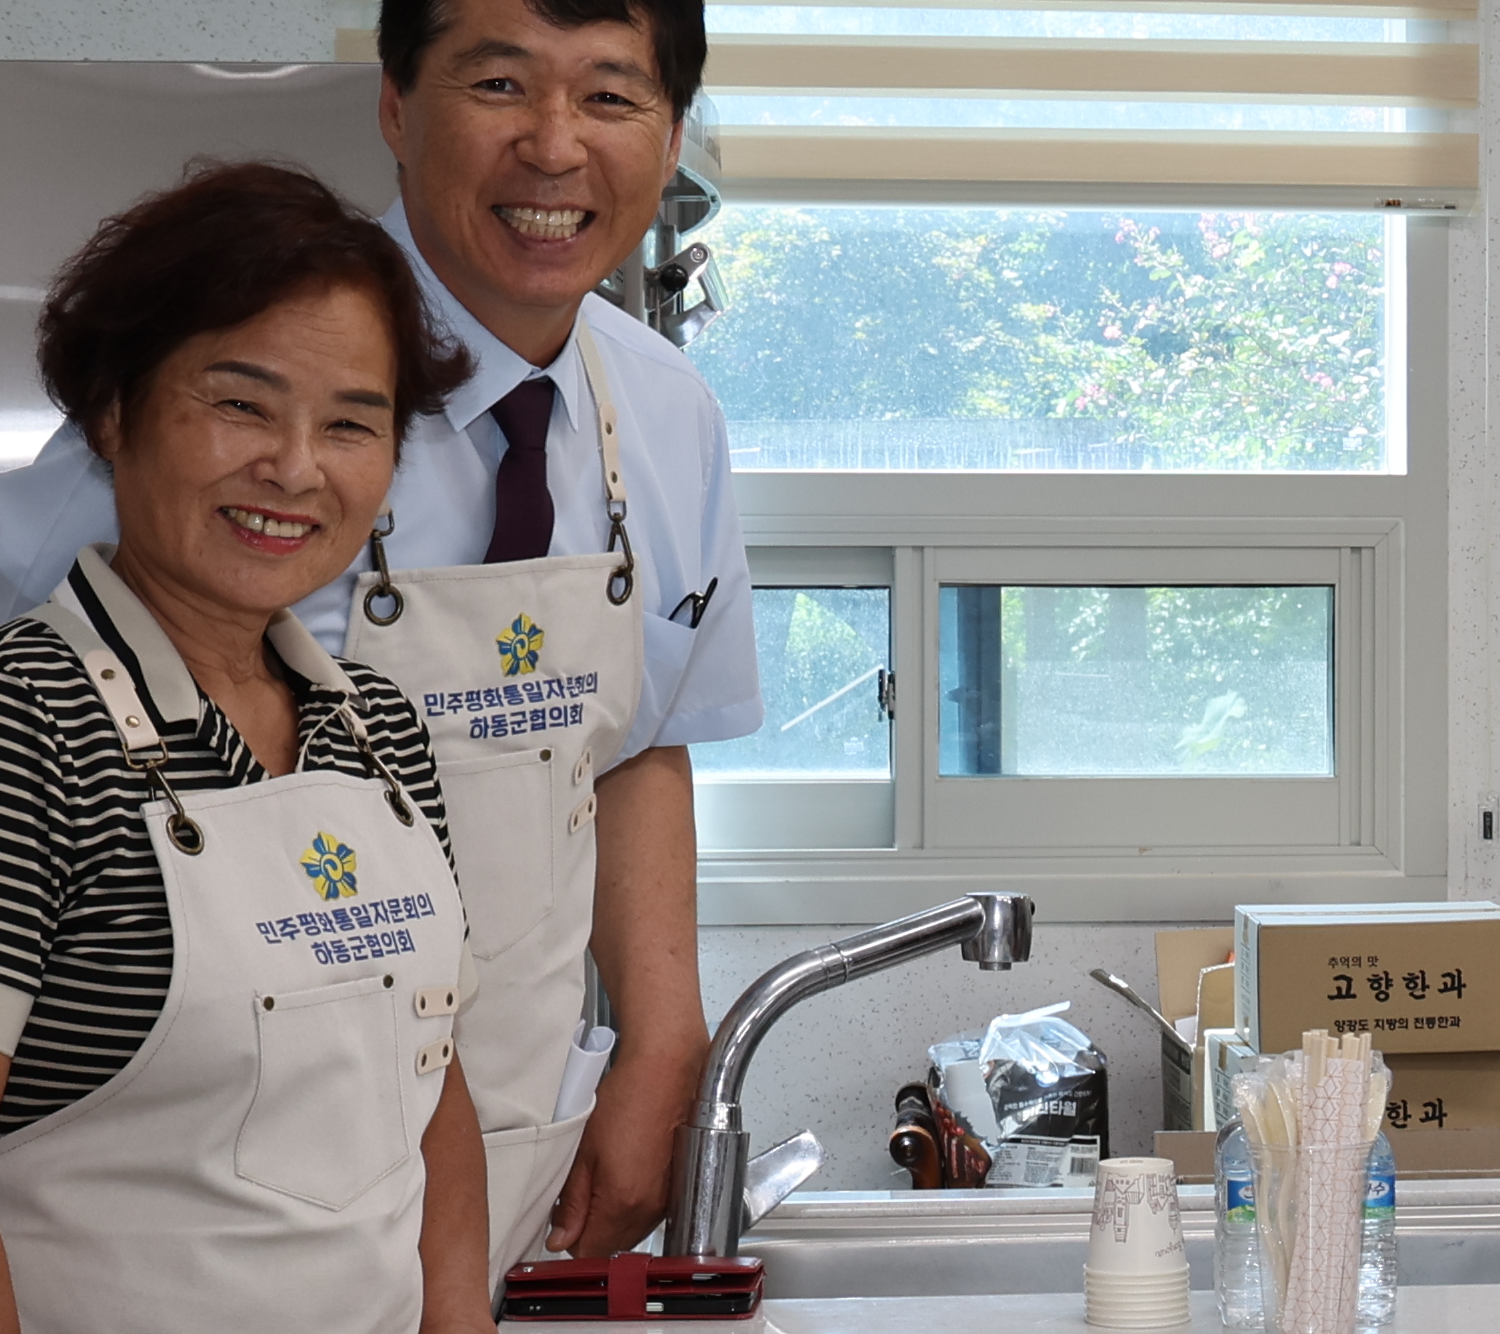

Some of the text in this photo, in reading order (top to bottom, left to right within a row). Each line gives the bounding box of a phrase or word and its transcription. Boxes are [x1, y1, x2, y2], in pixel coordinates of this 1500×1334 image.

[423, 671, 599, 717] 민주평화통일자문회의
[469, 702, 584, 740] 하동군협의회
[255, 892, 436, 945] 민주평화통일자문회의
[310, 928, 416, 966] 하동군협의회
[1328, 955, 1379, 968] 추억의 맛
[1385, 1097, 1448, 1129] 한과
